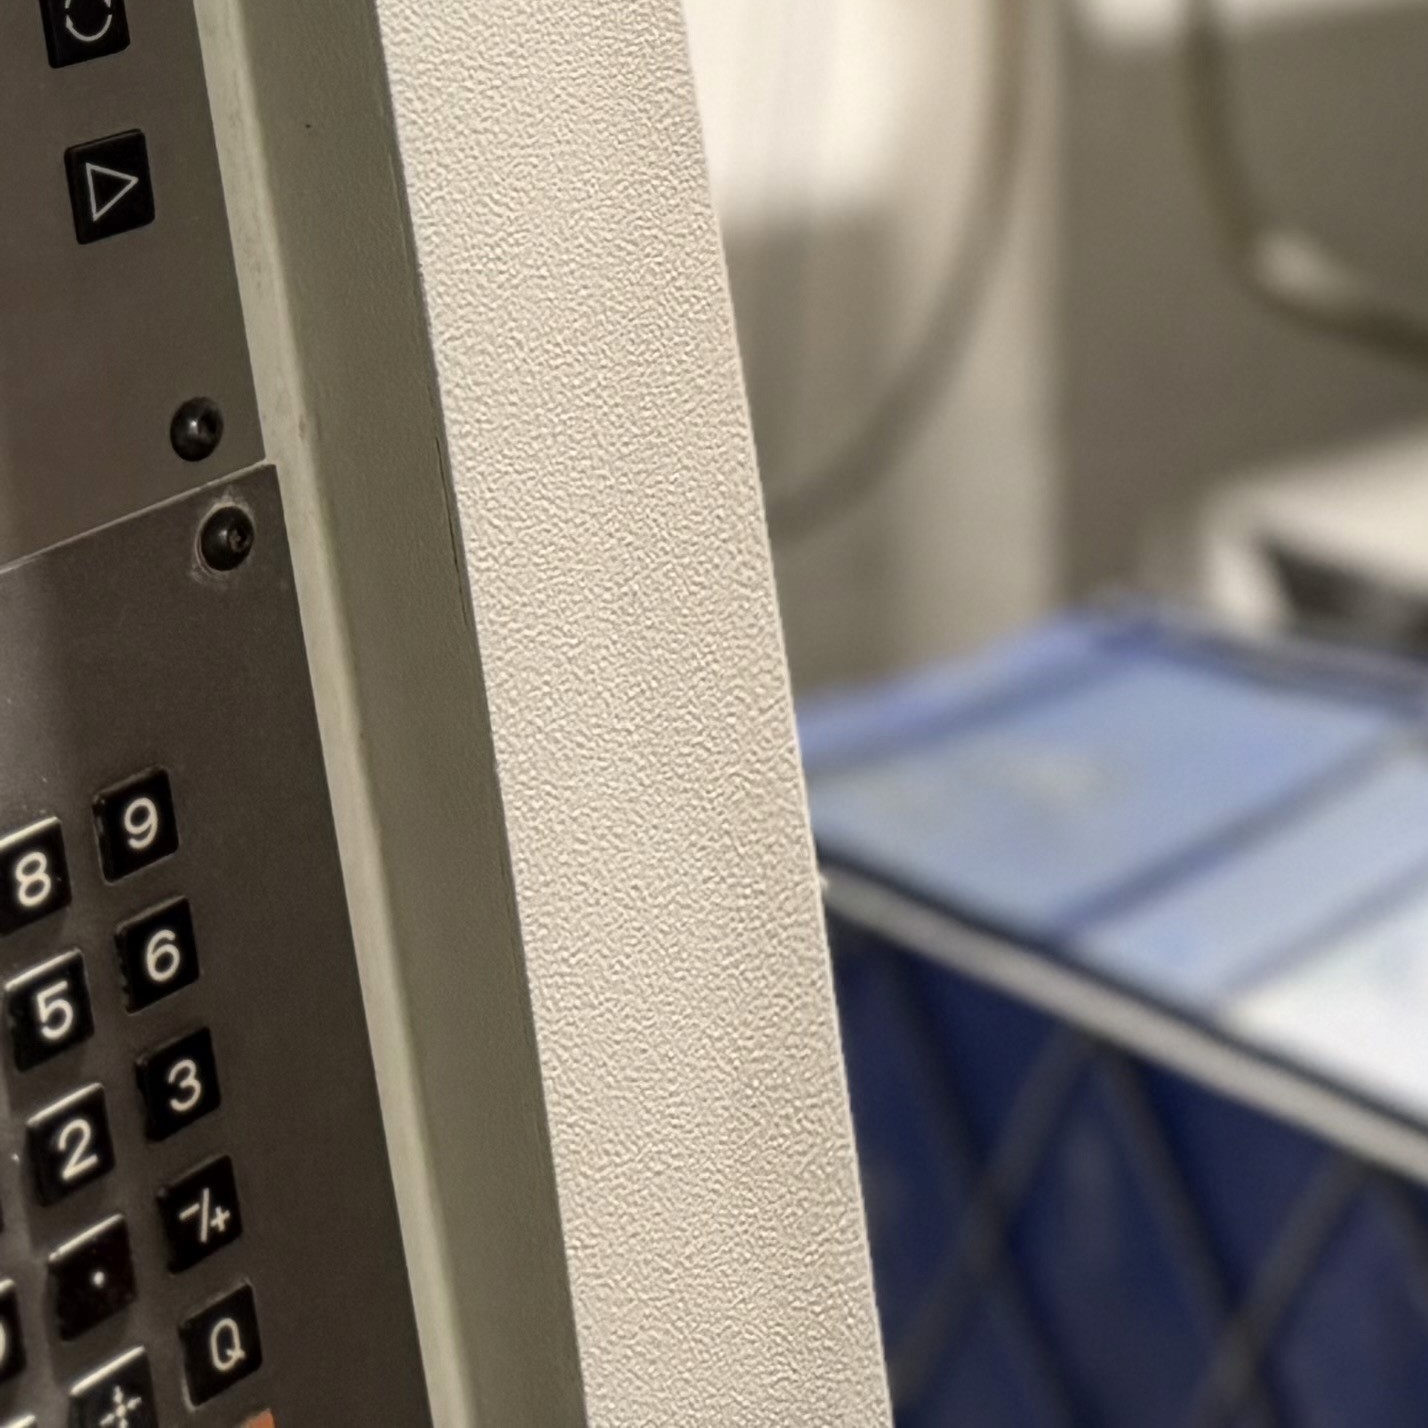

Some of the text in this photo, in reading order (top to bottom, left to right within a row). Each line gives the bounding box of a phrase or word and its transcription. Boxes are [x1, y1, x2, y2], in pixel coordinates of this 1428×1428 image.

[124, 797, 159, 850] 9
[15, 851, 51, 907] 8
[146, 929, 181, 983] 6
[35, 980, 74, 1040] 5
[168, 1059, 202, 1112] 3
[58, 1118, 98, 1181] 2
[210, 1317, 246, 1371] Q
